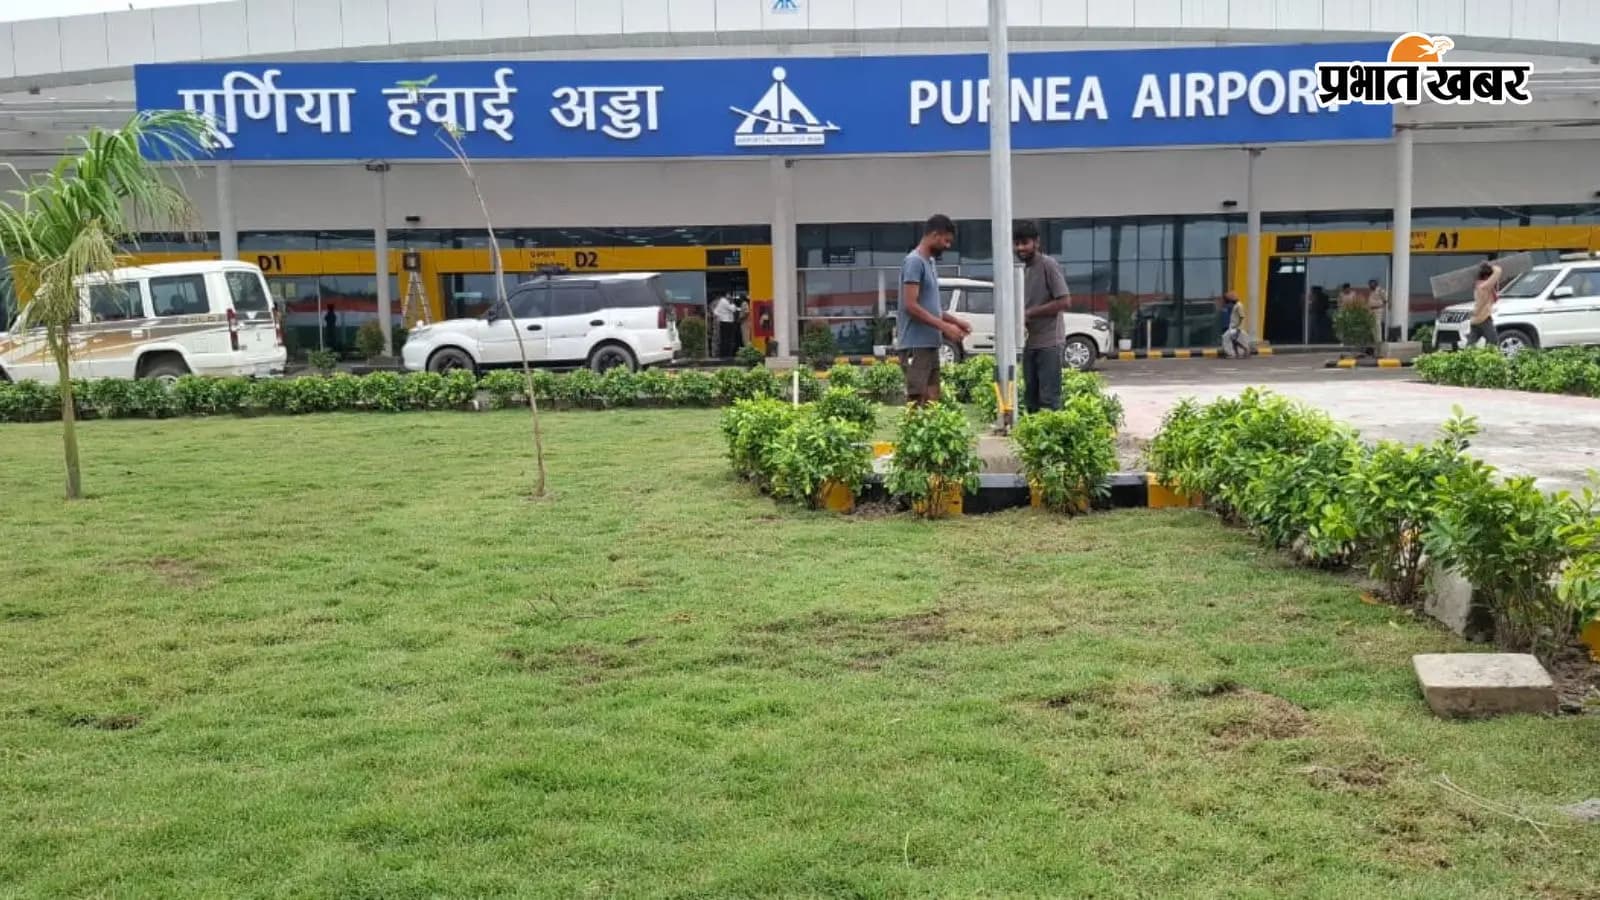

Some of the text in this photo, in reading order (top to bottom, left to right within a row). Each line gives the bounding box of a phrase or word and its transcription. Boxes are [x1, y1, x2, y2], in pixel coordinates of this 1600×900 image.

[1132, 69, 1340, 118] AIRPOR
[177, 68, 664, 148] पूर्णिया हवाई अड्डा
[1435, 232, 1459, 249] A1
[258, 255, 281, 271] D1
[575, 251, 599, 268] D2
